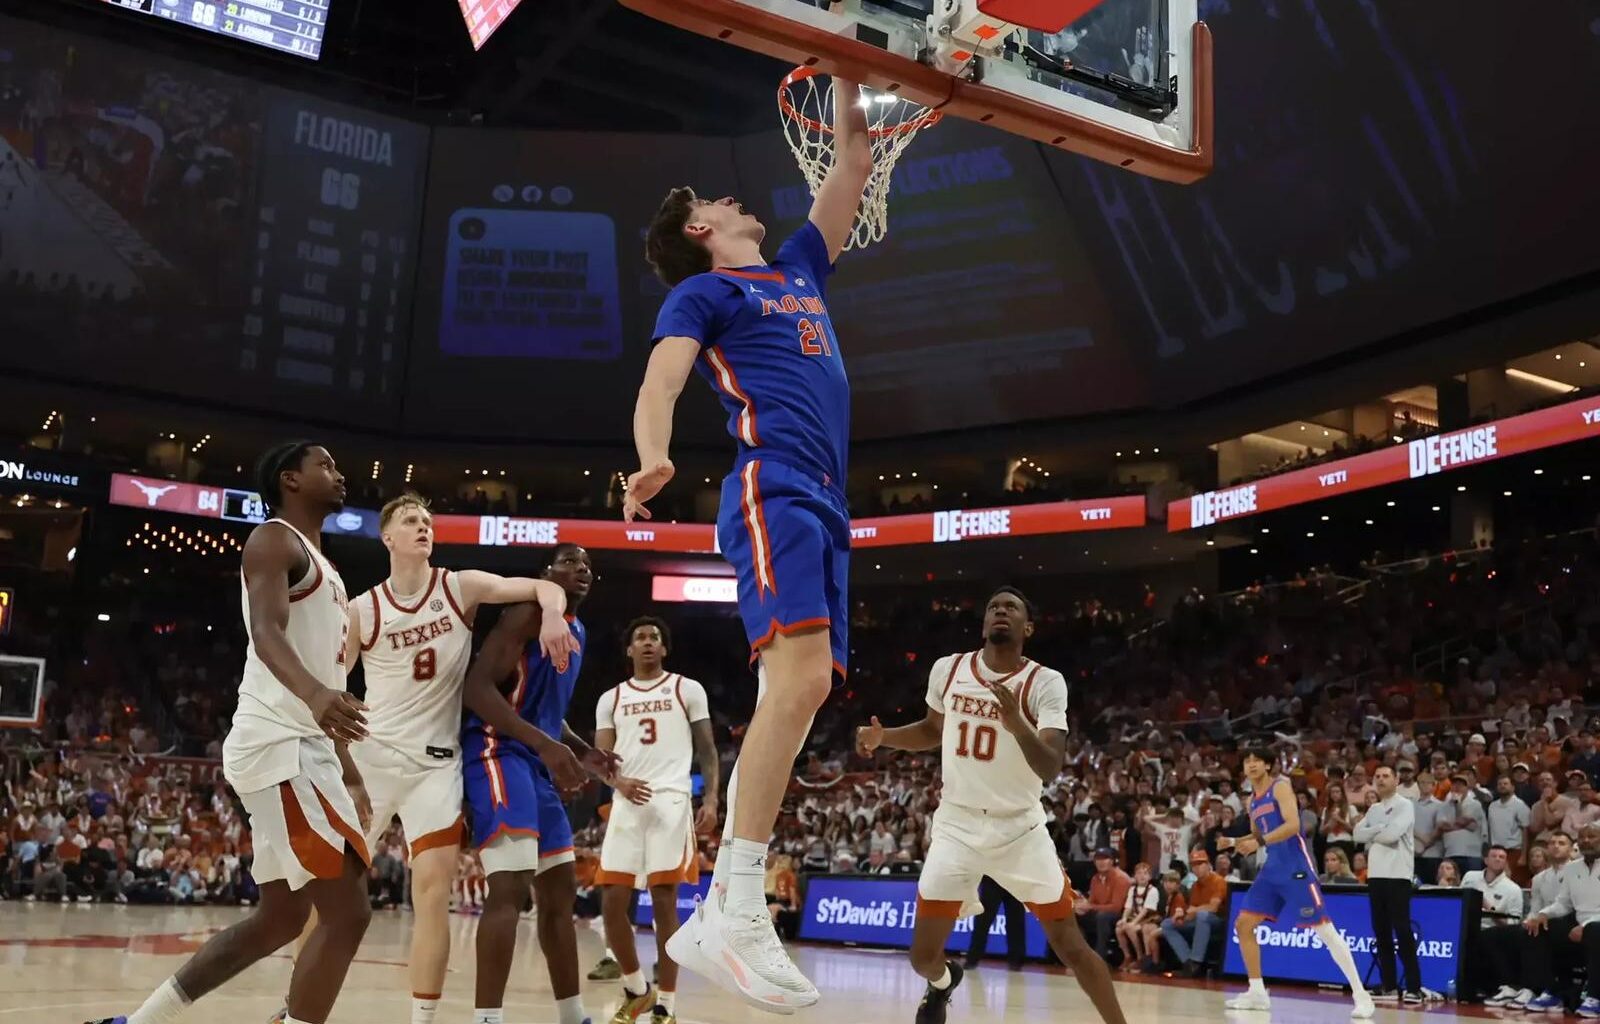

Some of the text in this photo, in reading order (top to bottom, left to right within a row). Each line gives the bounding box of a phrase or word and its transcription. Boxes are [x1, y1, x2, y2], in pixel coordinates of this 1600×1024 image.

[192, 1, 217, 26] 66
[294, 110, 393, 167] FLORIDA
[320, 167, 360, 210] 66
[798, 318, 831, 356] 21
[1408, 425, 1497, 480] DEFENSE
[26, 469, 79, 487] LOUNGE
[1318, 470, 1347, 487] YETI
[198, 490, 219, 511] 64
[1080, 508, 1111, 521] YETI
[1191, 485, 1256, 529] DEFENSE
[479, 515, 559, 545] DEFENSE
[625, 529, 655, 542] YETI
[850, 527, 877, 539] YETI
[933, 509, 1010, 543] DEFENSE
[387, 615, 454, 651] TEXAS
[413, 647, 437, 681] 8
[622, 699, 673, 716] TEXAS
[952, 693, 1001, 720] TEXA
[639, 717, 657, 745] 3
[956, 720, 997, 761] 10
